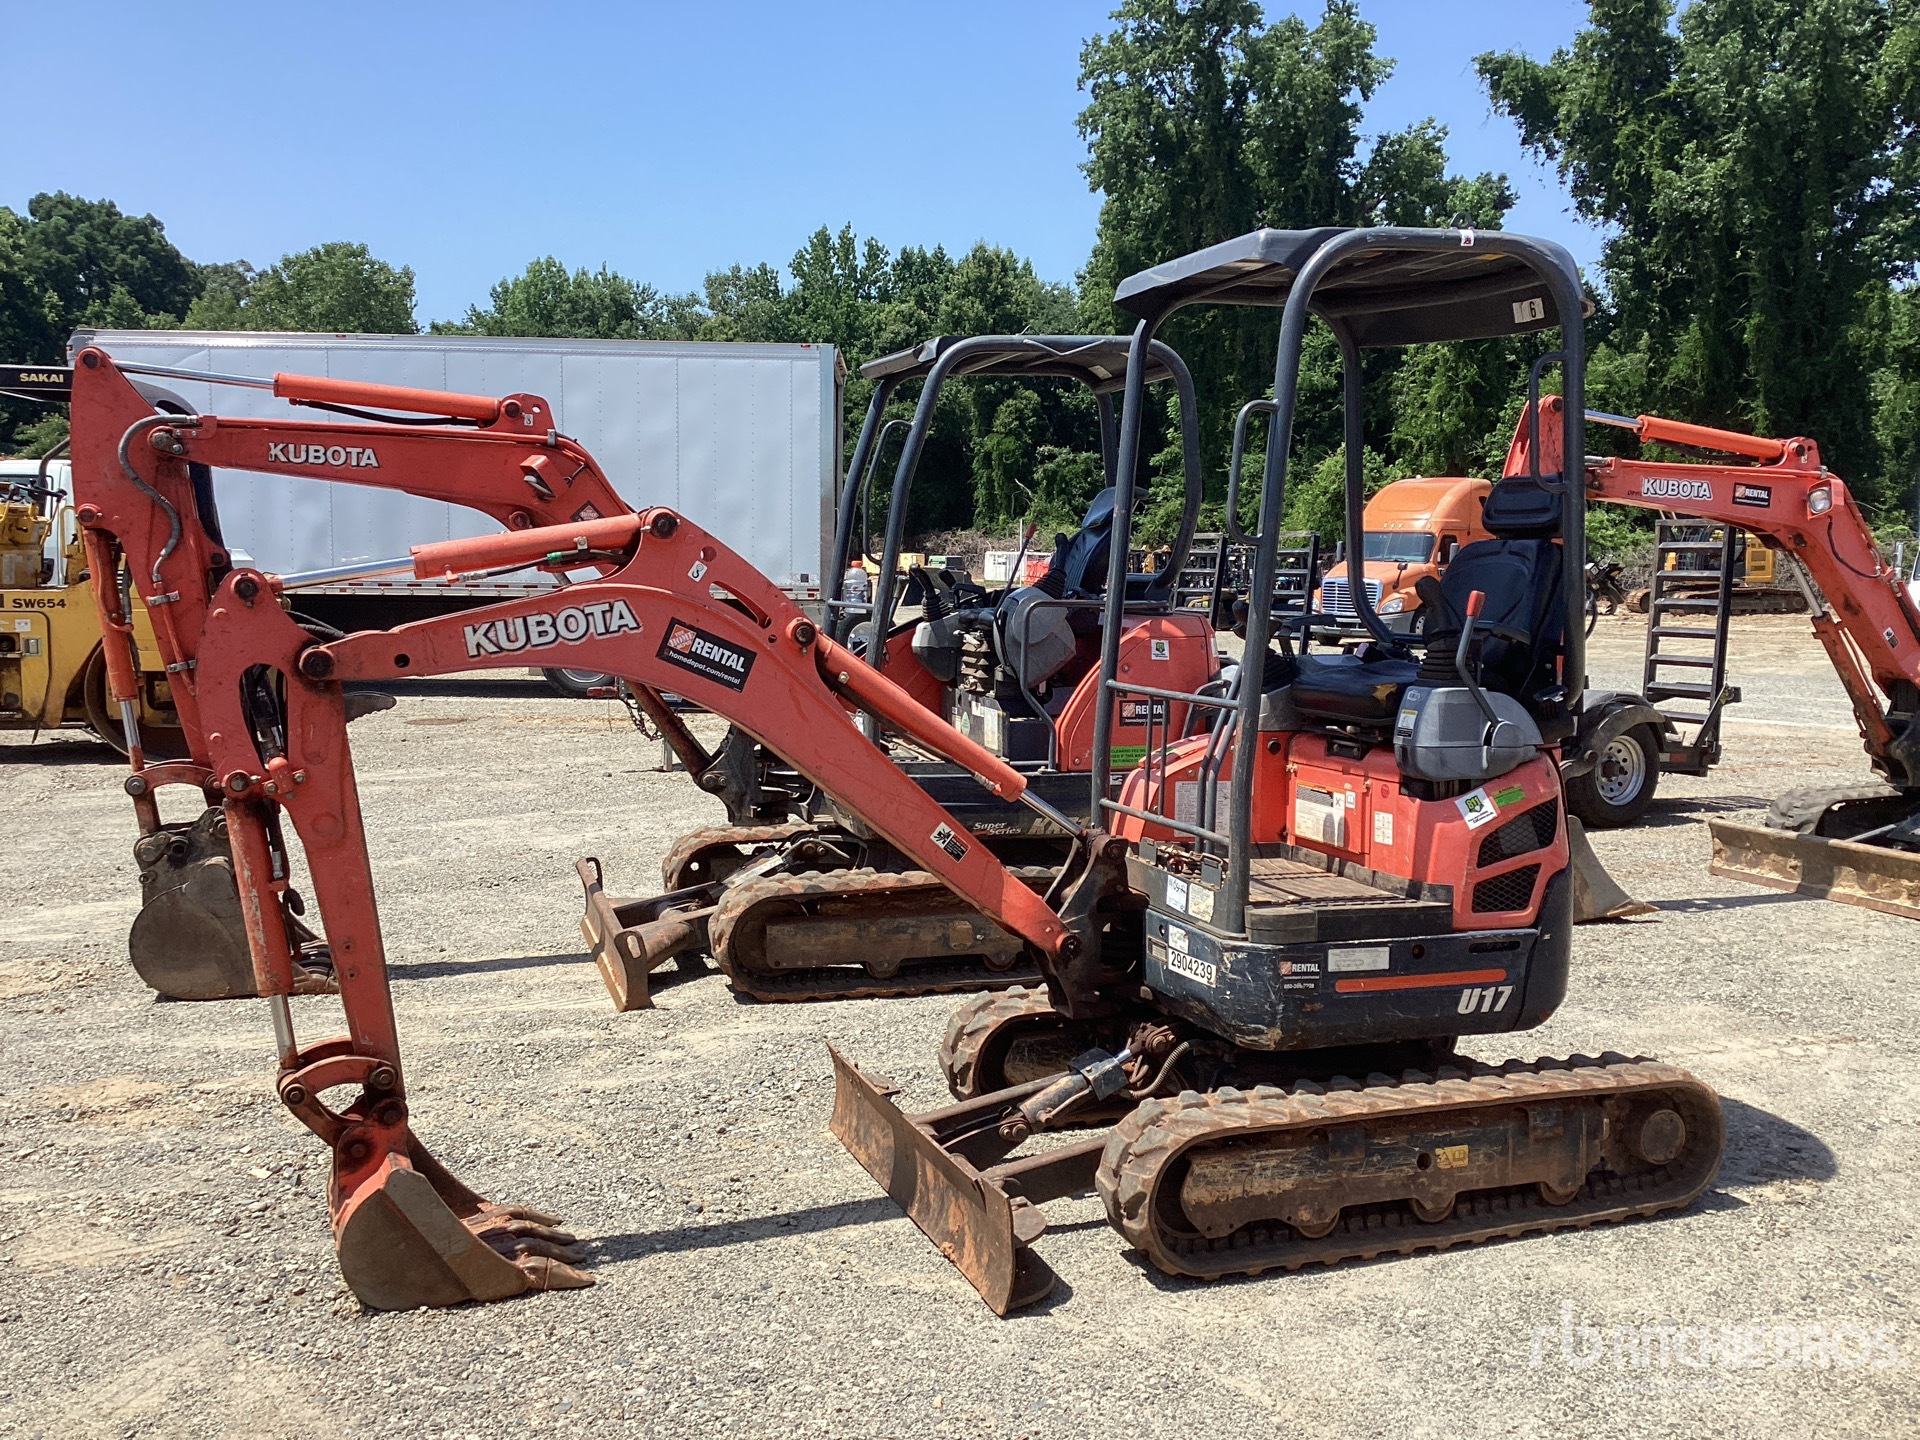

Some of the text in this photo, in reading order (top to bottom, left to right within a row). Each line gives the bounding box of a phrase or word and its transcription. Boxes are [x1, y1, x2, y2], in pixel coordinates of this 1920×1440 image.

[1529, 301, 1537, 318] 6
[19, 372, 65, 383] SAKAI
[268, 442, 380, 468] KUBOTA
[1643, 478, 1712, 499] KUBOTA
[1745, 488, 1770, 499] RENTAL
[12, 598, 67, 609] SW654
[463, 600, 640, 658] KUBOTA
[667, 631, 697, 649] HOME
[691, 637, 745, 673] RENTAL
[668, 650, 741, 685] homedepot.com/rental
[1135, 704, 1164, 715] RETA
[1466, 796, 1480, 810] 811
[973, 822, 1007, 831] Super
[987, 827, 1022, 836] Series
[1171, 950, 1213, 981] 2904239
[1291, 963, 1320, 973] RENTAL
[1457, 985, 1514, 1015] U17
